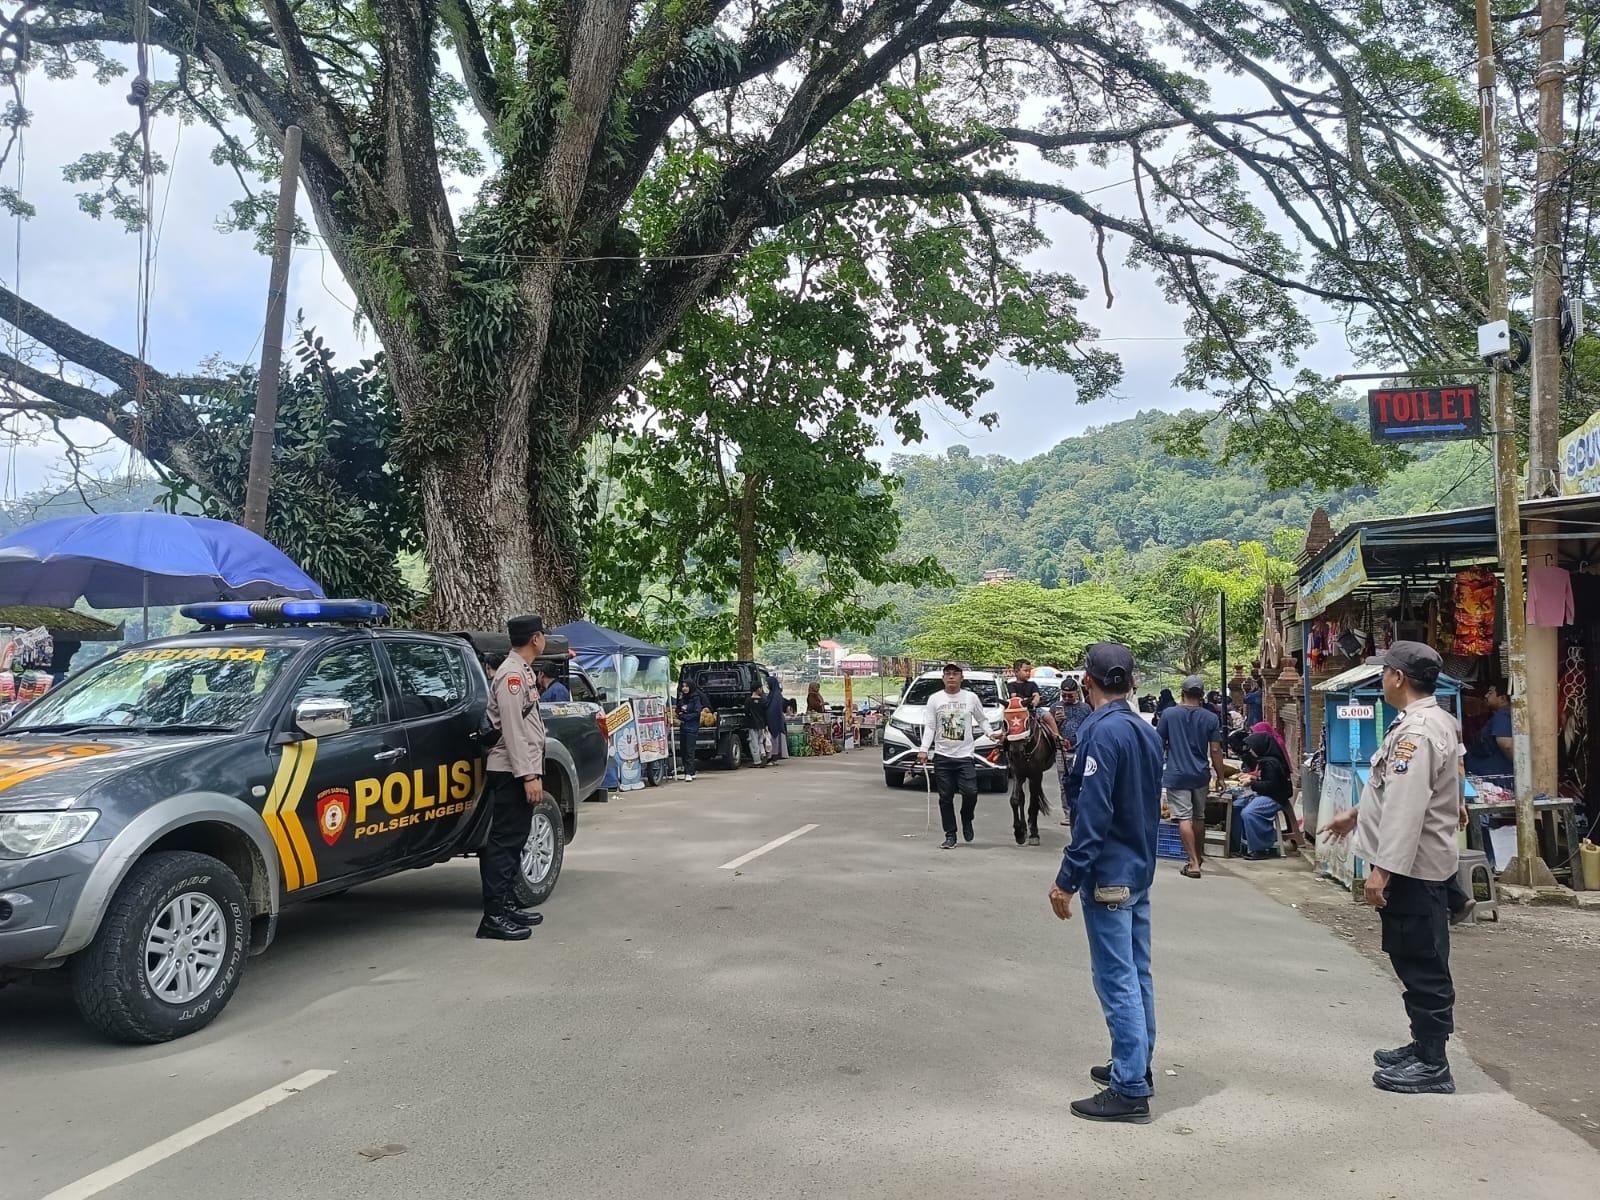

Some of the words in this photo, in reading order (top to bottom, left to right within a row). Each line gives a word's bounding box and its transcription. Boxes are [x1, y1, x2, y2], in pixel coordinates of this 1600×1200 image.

[1374, 389, 1475, 424] TOILET
[114, 647, 266, 665] SABHARA
[1341, 708, 1370, 717] 5.000
[355, 758, 483, 824] POLISI
[354, 812, 421, 839] POLSEK
[425, 800, 474, 821] NGEBE
